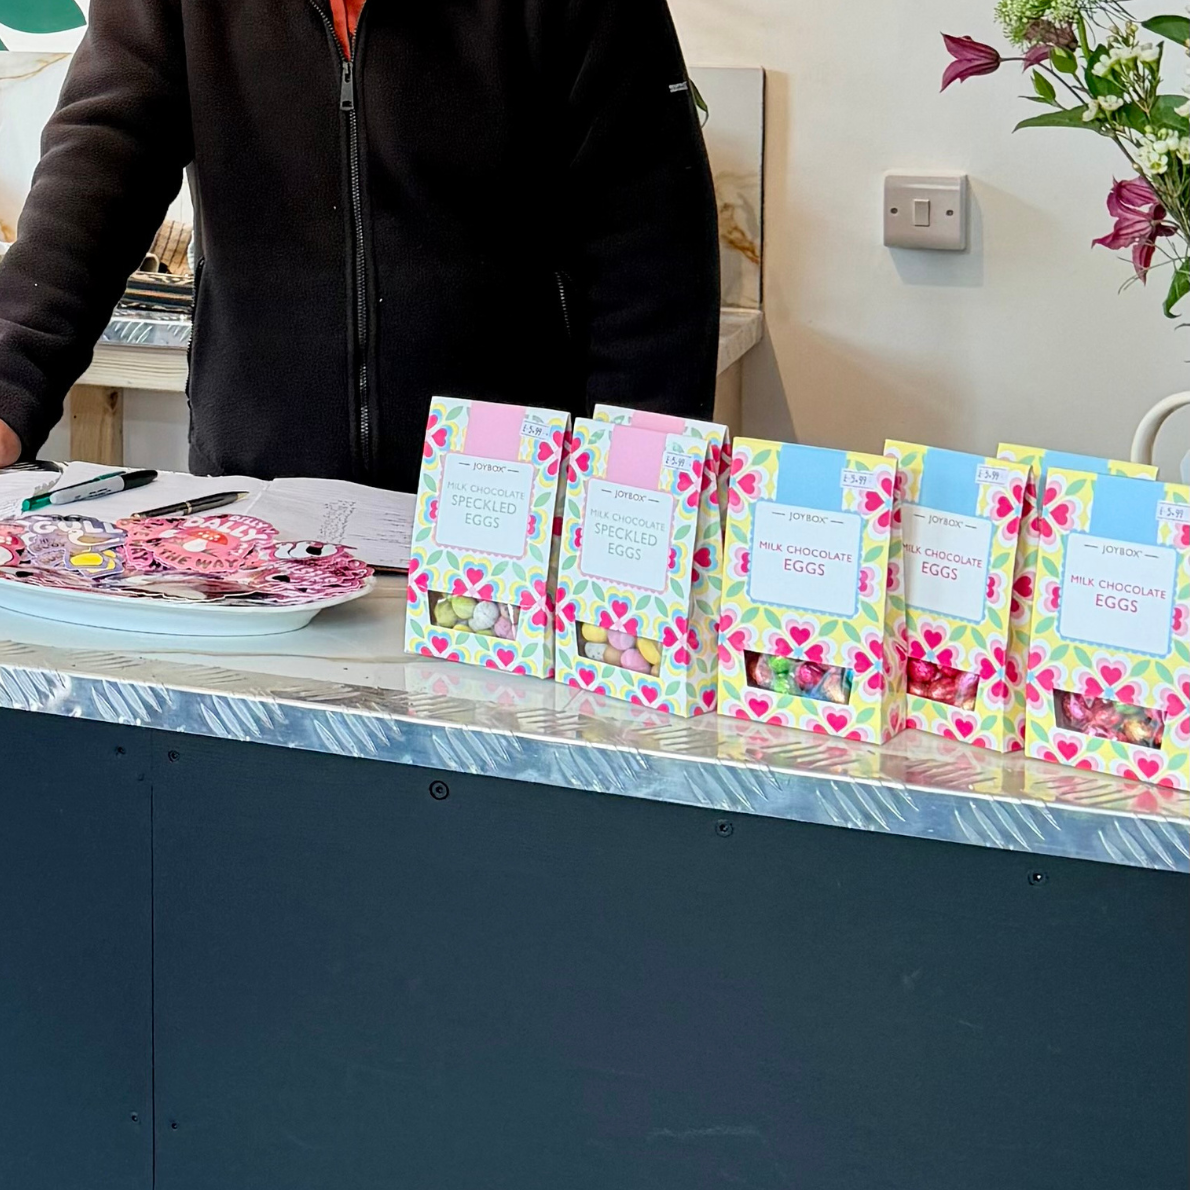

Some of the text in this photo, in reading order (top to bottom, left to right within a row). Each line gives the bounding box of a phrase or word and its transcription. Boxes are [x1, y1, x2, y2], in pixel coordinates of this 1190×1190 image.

[447, 481, 525, 500] MILK CHOCOLATE
[451, 494, 517, 515] SPECKLED
[183, 516, 267, 542] DALLY
[465, 512, 500, 529] EGGS
[590, 508, 665, 532] MILK CHOCOLATE
[594, 522, 658, 547] SPECKLED
[608, 542, 641, 561] EGGS
[759, 541, 852, 563] MILK CHOCOLATE
[925, 548, 982, 568] CHOCOLATE
[195, 558, 238, 569] WAY
[784, 558, 825, 576] EGGS
[921, 561, 958, 580] EGGS
[1070, 575, 1166, 599] MILK CHOCOLATE
[1095, 594, 1138, 613] EGGS
